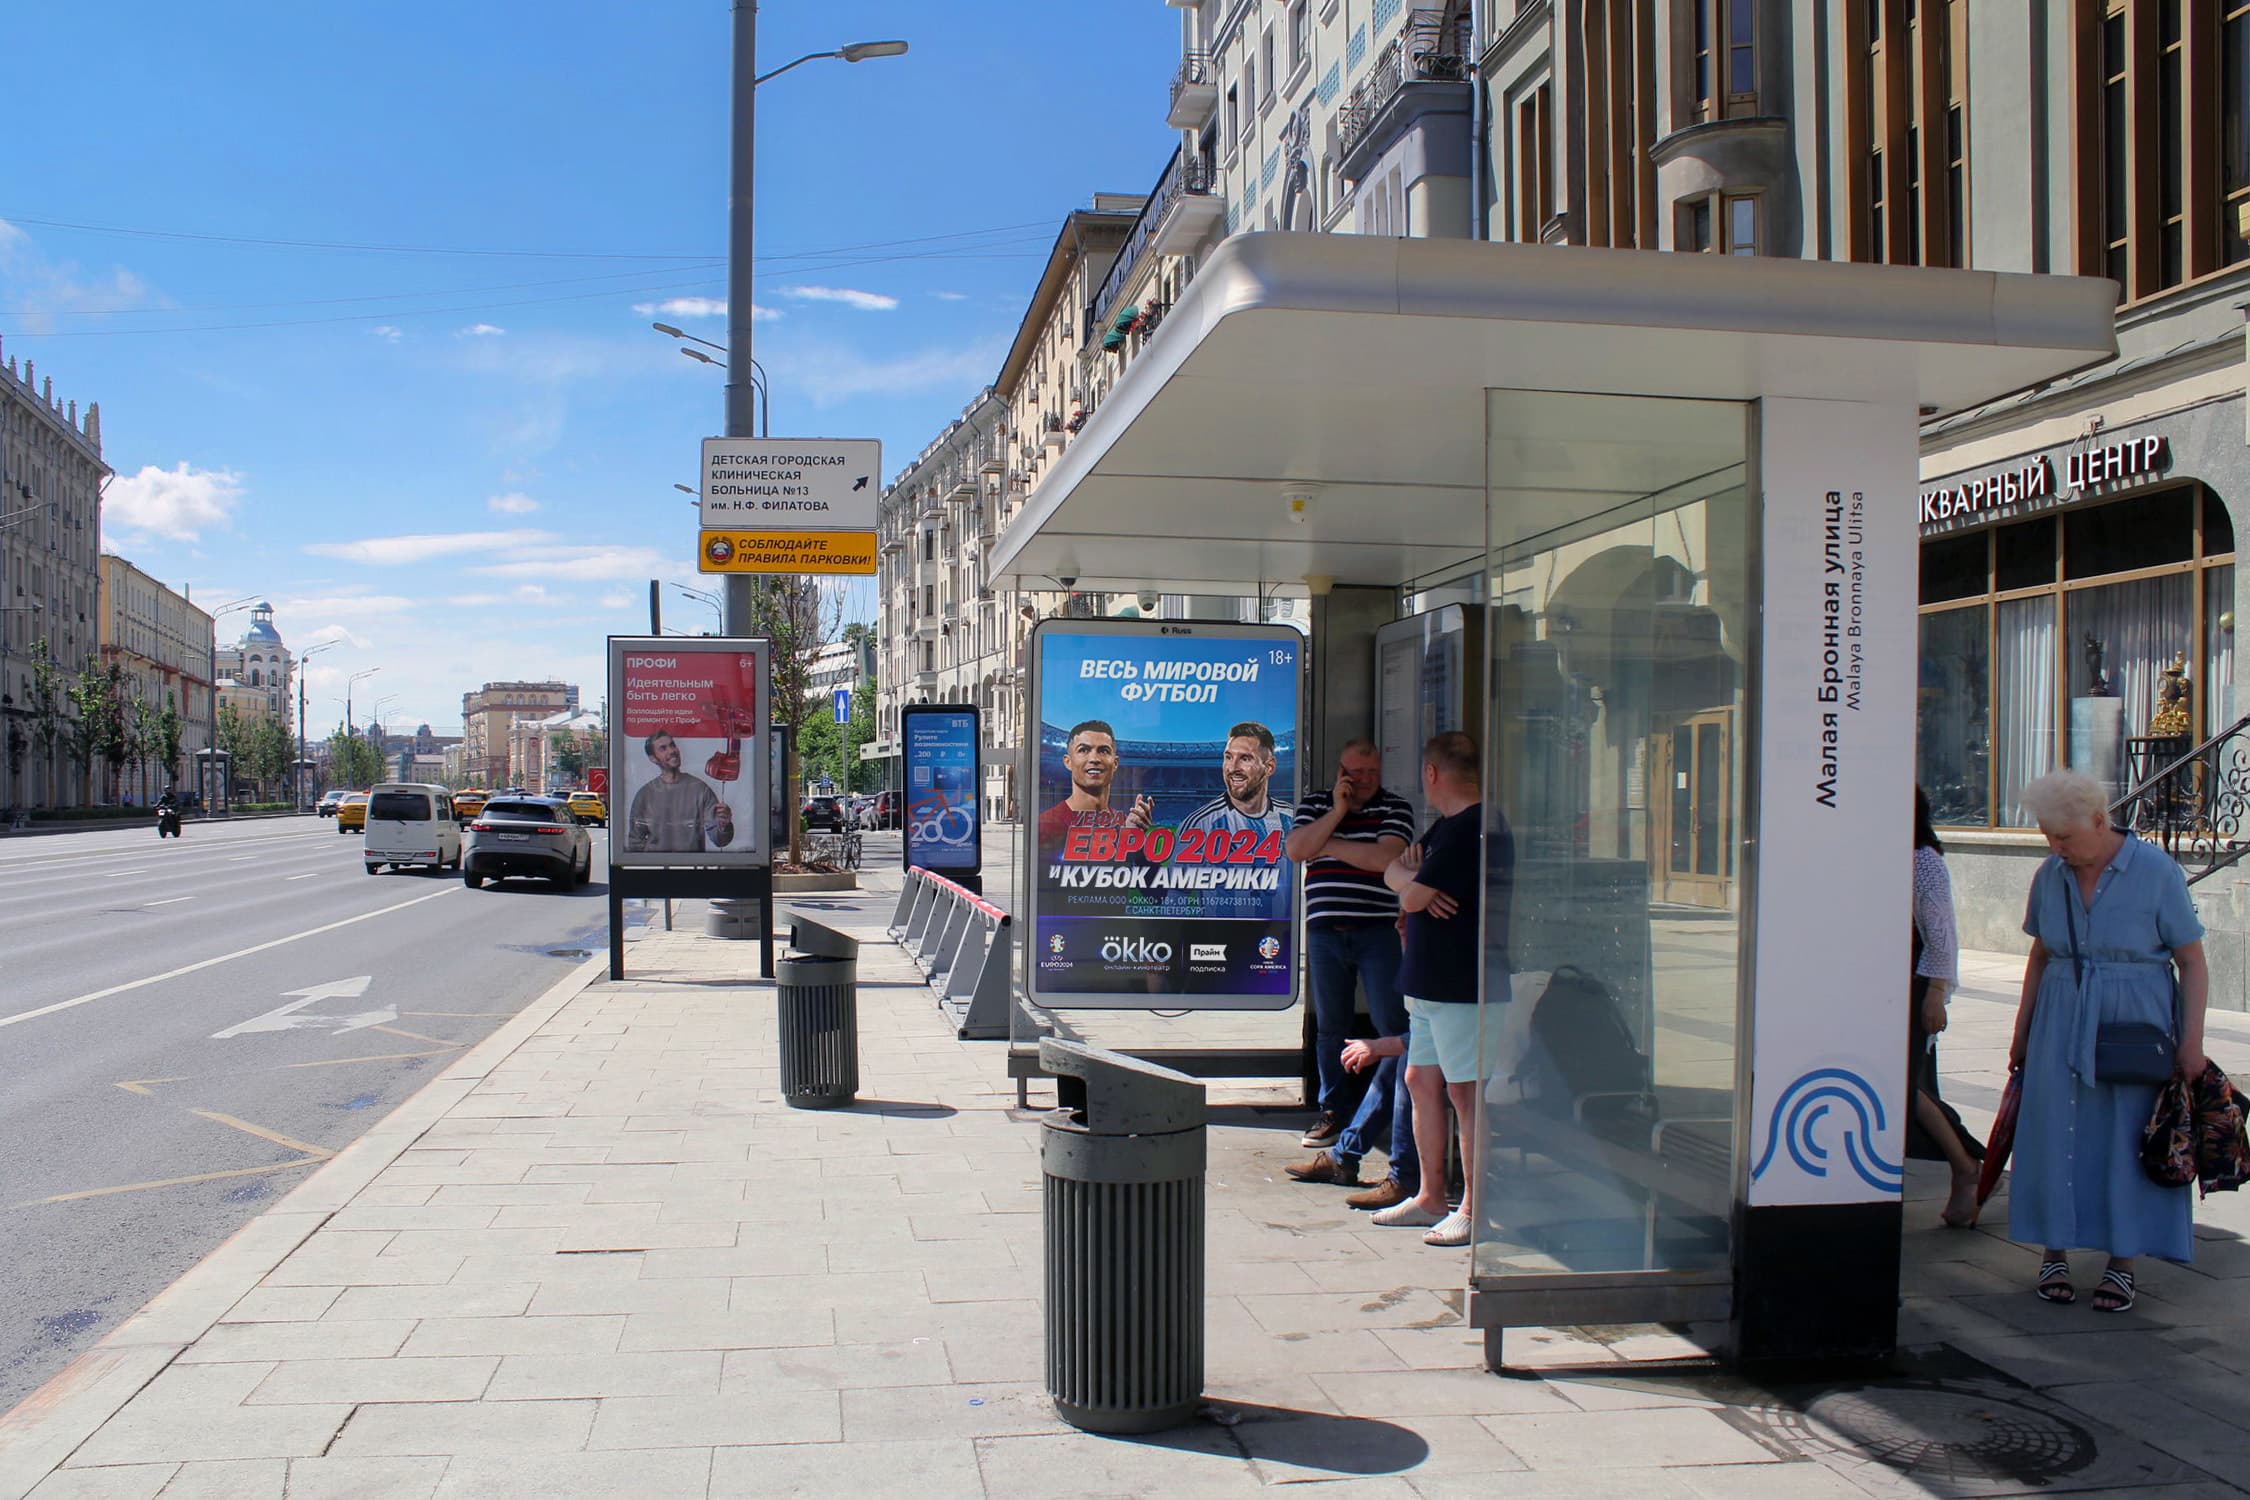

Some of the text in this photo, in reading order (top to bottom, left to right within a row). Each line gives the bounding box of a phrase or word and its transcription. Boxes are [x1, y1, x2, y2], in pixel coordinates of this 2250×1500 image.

[711, 455, 845, 466] ДЕТСКАЯ ГОРОДСКАЯ
[2066, 434, 2160, 492] ЦЕНТР
[711, 470, 801, 480] КЛИНИЧЕСКАЯ
[711, 485, 809, 496] БОЛЬНИЦА №13
[711, 501, 829, 511] им. Н.Ф. ФИЛАТОВА
[738, 537, 828, 551] СОБЛЮДАЙТЕ
[738, 553, 872, 565] ПРАВИЛА ПАРКОВКИ!
[1846, 490, 1866, 711] Malaya Bronnaya Ulitsa
[1171, 626, 1192, 634] Russ
[1815, 490, 1845, 808] Малая Бронная улица
[626, 657, 677, 669] ПРОФИ
[739, 659, 753, 668] 6+
[1268, 650, 1293, 665] 18+
[1079, 658, 1260, 682] ВЕСЬ МИРОВОЙ
[626, 678, 714, 689] Идеятельным
[626, 691, 697, 701] быть легко
[1120, 683, 1219, 703] ФУТБОЛ
[951, 719, 969, 728] ВТБ
[1072, 810, 1128, 828] УЕФА
[1063, 826, 1284, 864] ЕВРО 2024
[1060, 865, 1149, 888] КУБОК
[1151, 867, 1280, 890] АМЕРИКИ
[1068, 895, 1108, 904] РЕКЛАМА
[1109, 896, 1127, 904] ООО
[1178, 896, 1199, 906] ОГРН
[1193, 948, 1221, 958] Прайм
